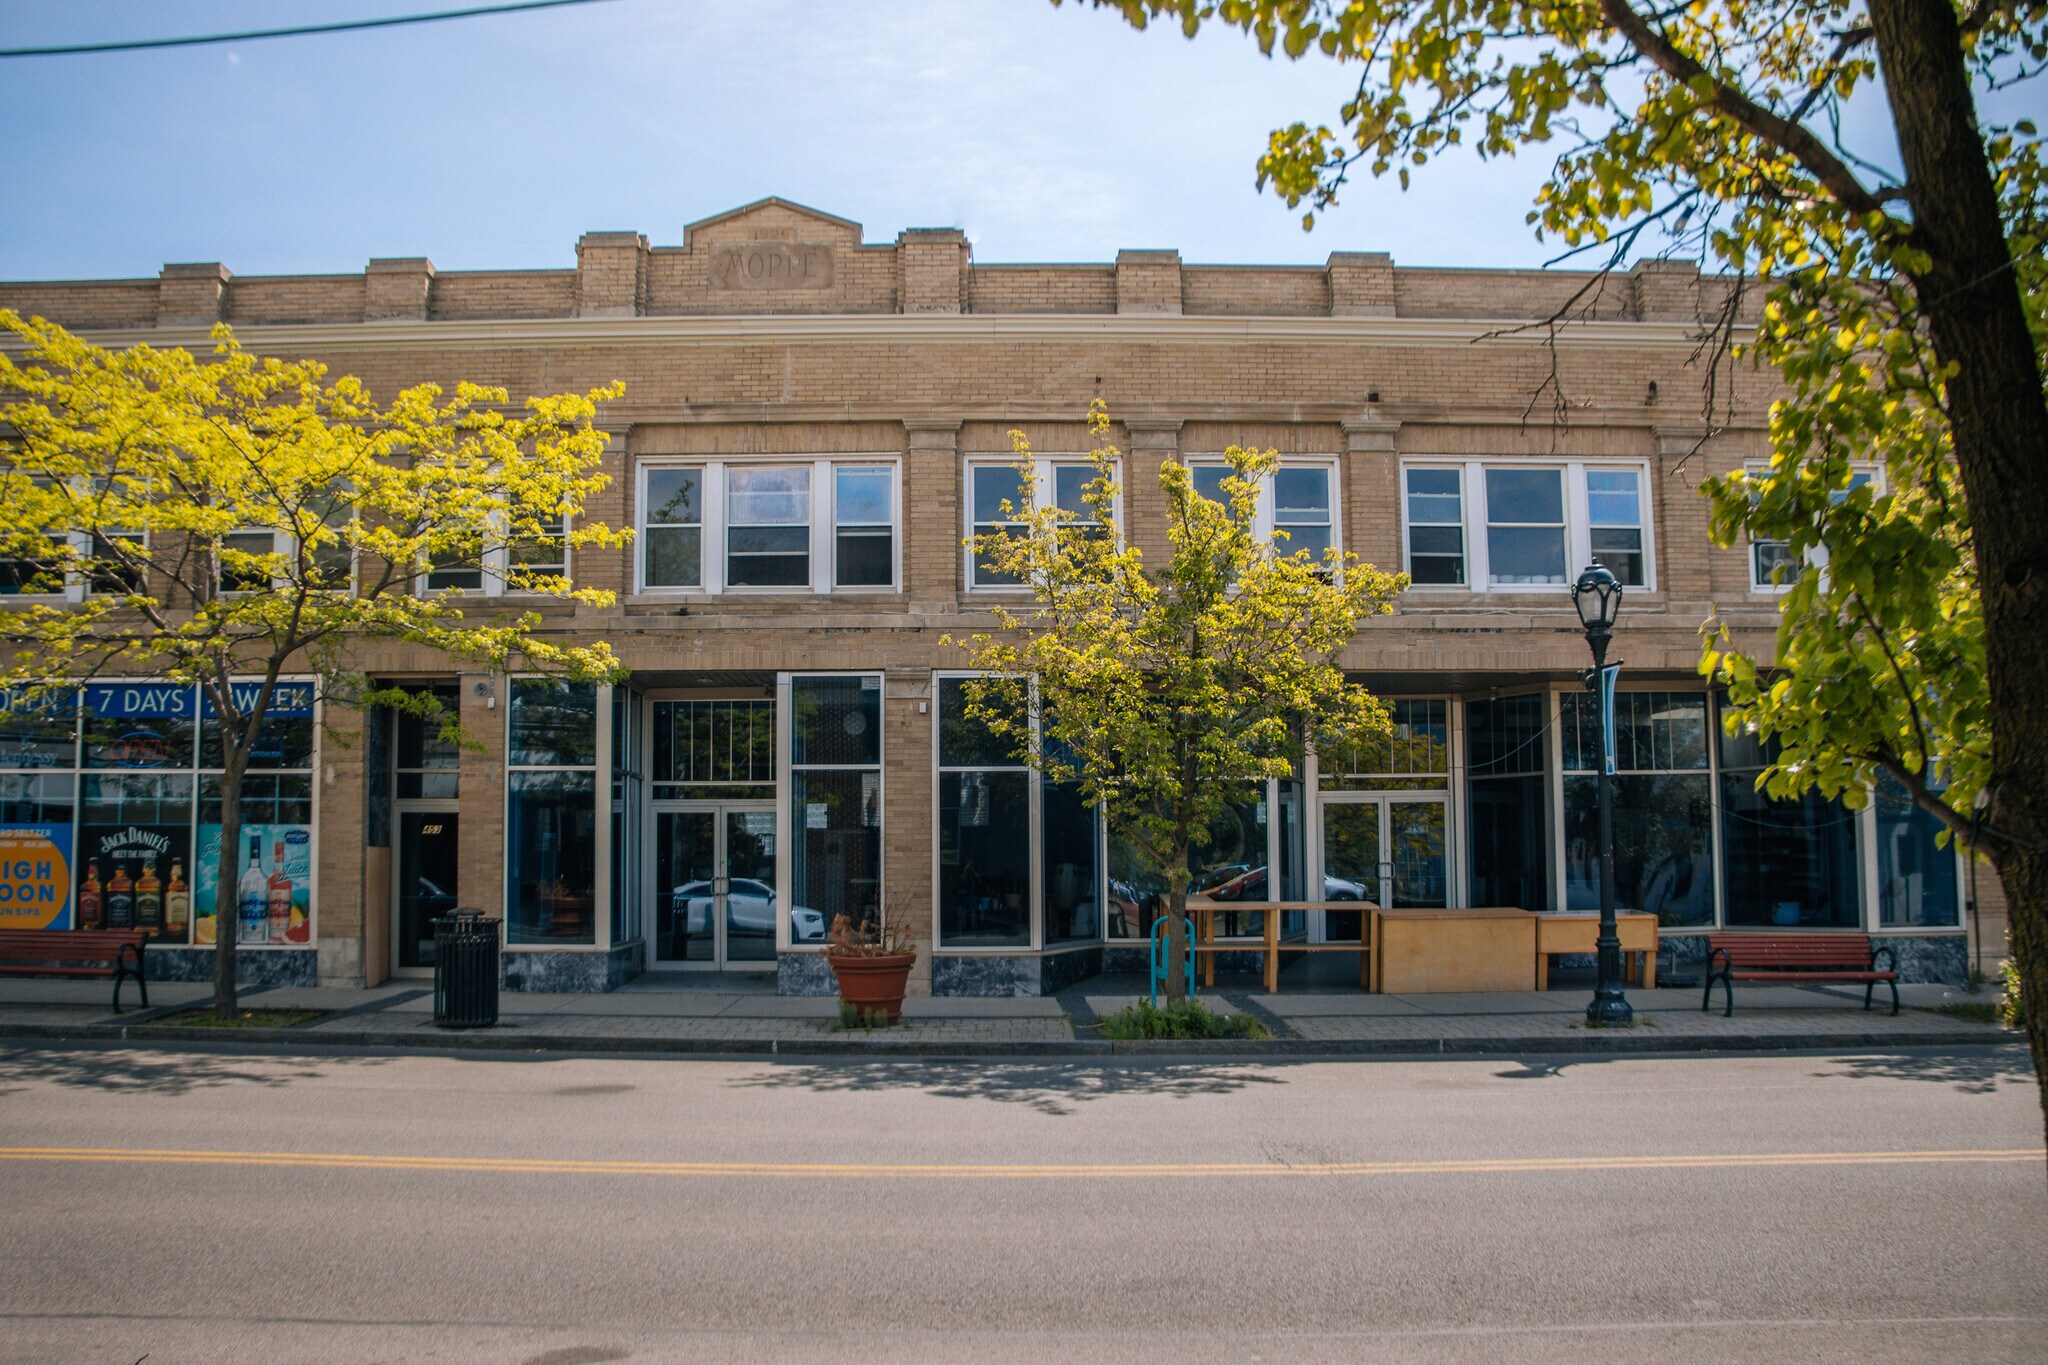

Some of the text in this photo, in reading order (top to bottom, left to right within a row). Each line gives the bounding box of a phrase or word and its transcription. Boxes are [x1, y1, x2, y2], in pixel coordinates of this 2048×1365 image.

[99, 689, 114, 712] 7
[124, 689, 185, 712] DAYS
[235, 688, 308, 712] WEK
[100, 831, 128, 854] JACK
[128, 826, 171, 853] DANIEL'S
[0, 884, 54, 902] OON
